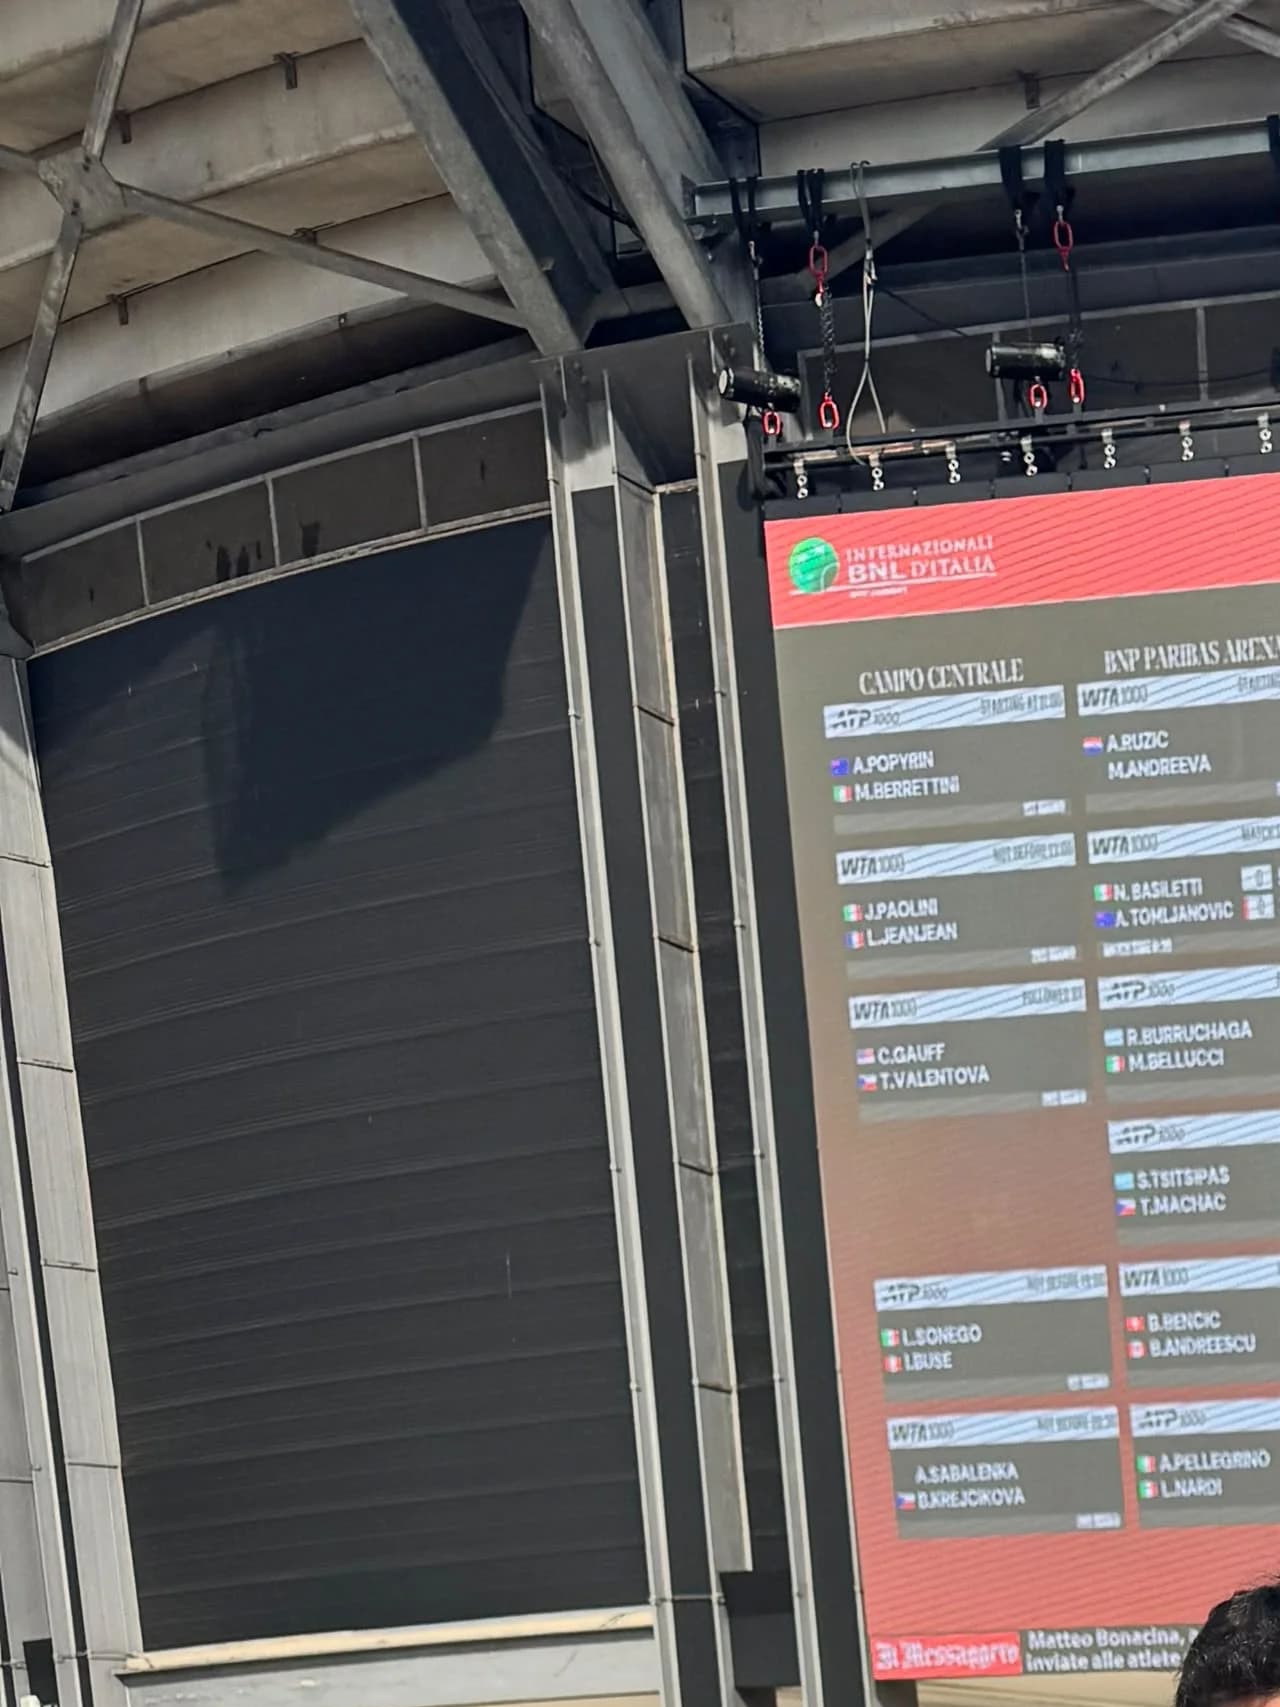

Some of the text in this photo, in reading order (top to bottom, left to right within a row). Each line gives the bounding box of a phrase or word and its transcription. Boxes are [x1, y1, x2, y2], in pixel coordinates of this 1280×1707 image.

[846, 535, 993, 561] INTERNAZIONALI
[849, 555, 995, 583] BNL D'ITALIA
[1104, 648, 1140, 674] BNP
[1144, 641, 1220, 671] PARIBAS
[859, 658, 1024, 695] CAMPO CENTRALE
[1107, 730, 1168, 752] A.RUZIC
[853, 750, 934, 775] A.POPYRIN
[1108, 754, 1212, 780] M.ANDREEVA
[854, 776, 960, 801] M.BERRETTINI
[1114, 883, 1129, 901] N.
[1132, 878, 1203, 900] BASILETTI
[865, 898, 938, 921] J.PAOLINI
[1131, 901, 1233, 925] TOMLJANOVIC
[867, 922, 958, 947] L.JEANJEAN
[1127, 1020, 1253, 1046] R.BURRUCHAGA
[878, 1042, 945, 1065] C.GAUFF
[1128, 1048, 1224, 1072] M.BELLUCCI
[880, 1065, 989, 1090] T.VALENTOVA
[1137, 1165, 1230, 1190] S.TSITSIPAS
[1140, 1192, 1226, 1216] T.MACHAC
[1147, 1310, 1221, 1332] B.BENCIC
[902, 1324, 982, 1347] L.SONEGO
[1150, 1333, 1256, 1358] B.ANDREESCU
[915, 1461, 1019, 1485] A.SABALENKA
[1160, 1448, 1271, 1474] A.PELLEGRINO
[1161, 1477, 1222, 1498] L.NARDI
[1028, 1630, 1092, 1651] Matteo
[1096, 1626, 1185, 1648] Bonacina,
[1027, 1649, 1182, 1673] inviate alle atlete
